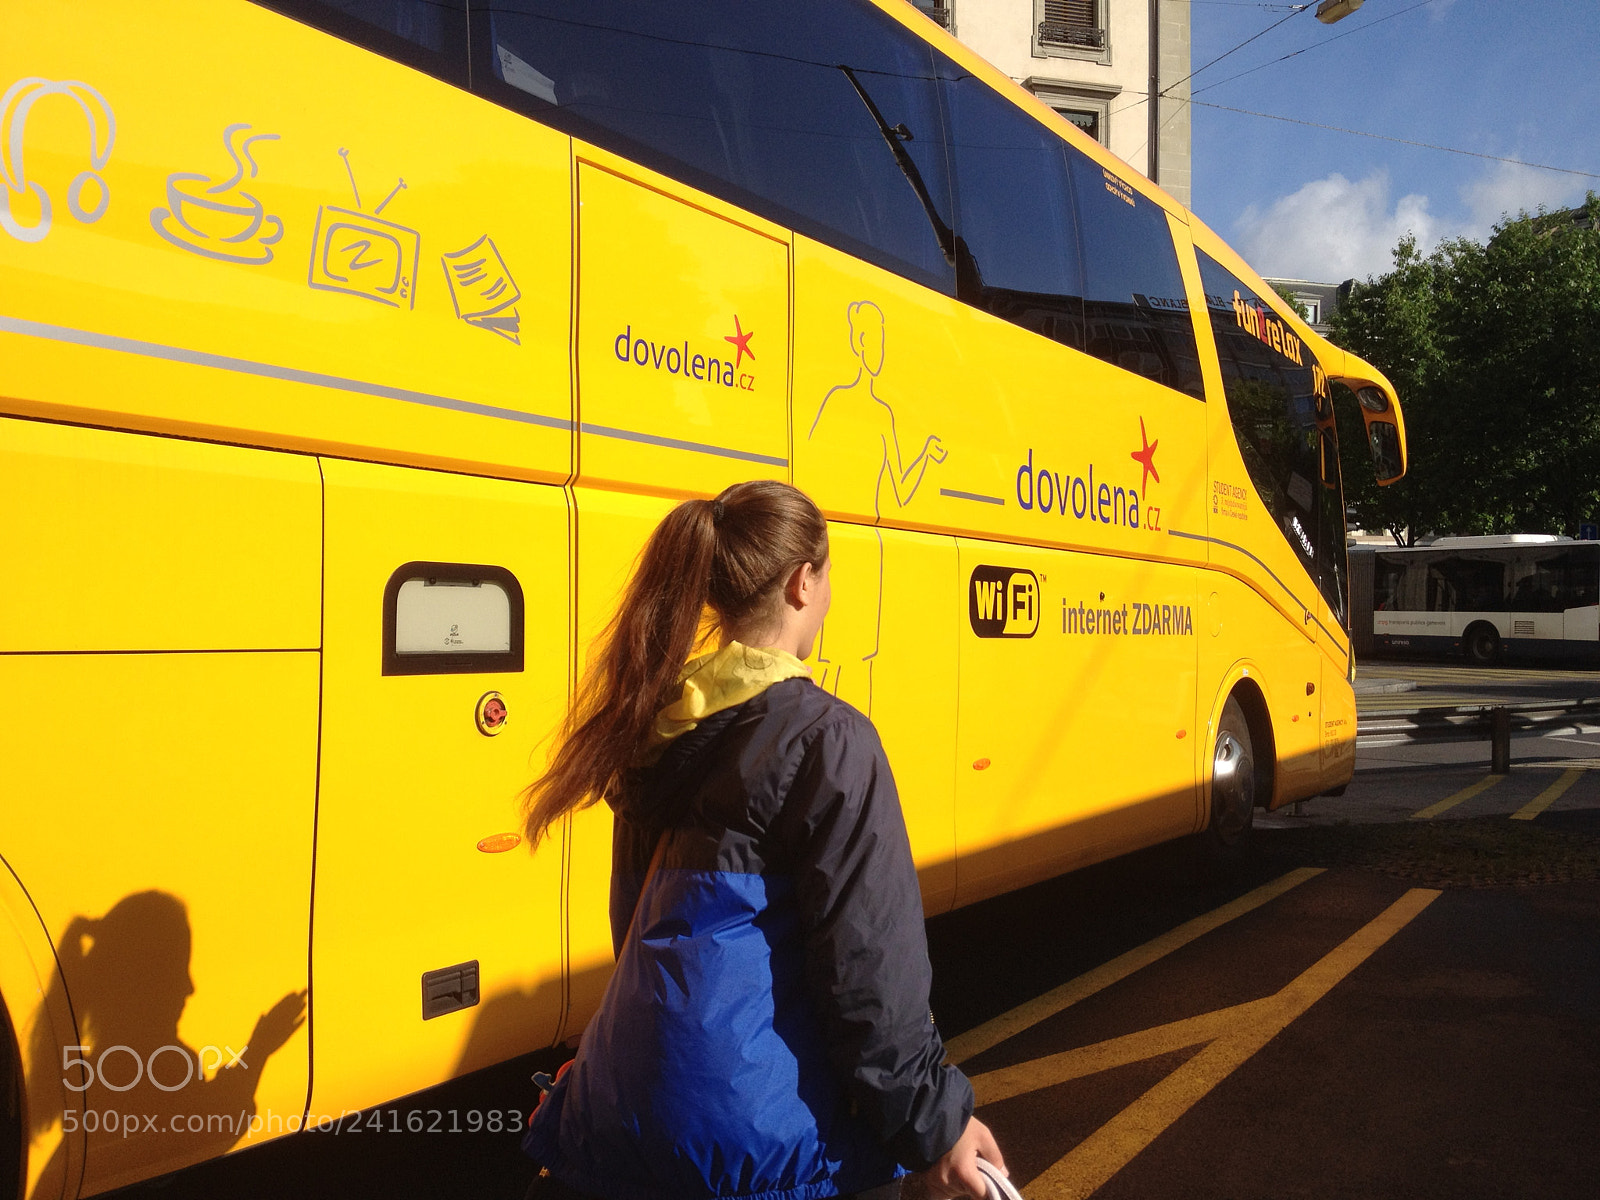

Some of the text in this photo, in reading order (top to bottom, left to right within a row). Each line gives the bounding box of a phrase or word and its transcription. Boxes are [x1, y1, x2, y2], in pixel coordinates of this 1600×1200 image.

[614, 325, 755, 392] dovolena.cz
[1016, 448, 1161, 531] dovolena.cz
[1062, 597, 1193, 635] internet ZDARMA
